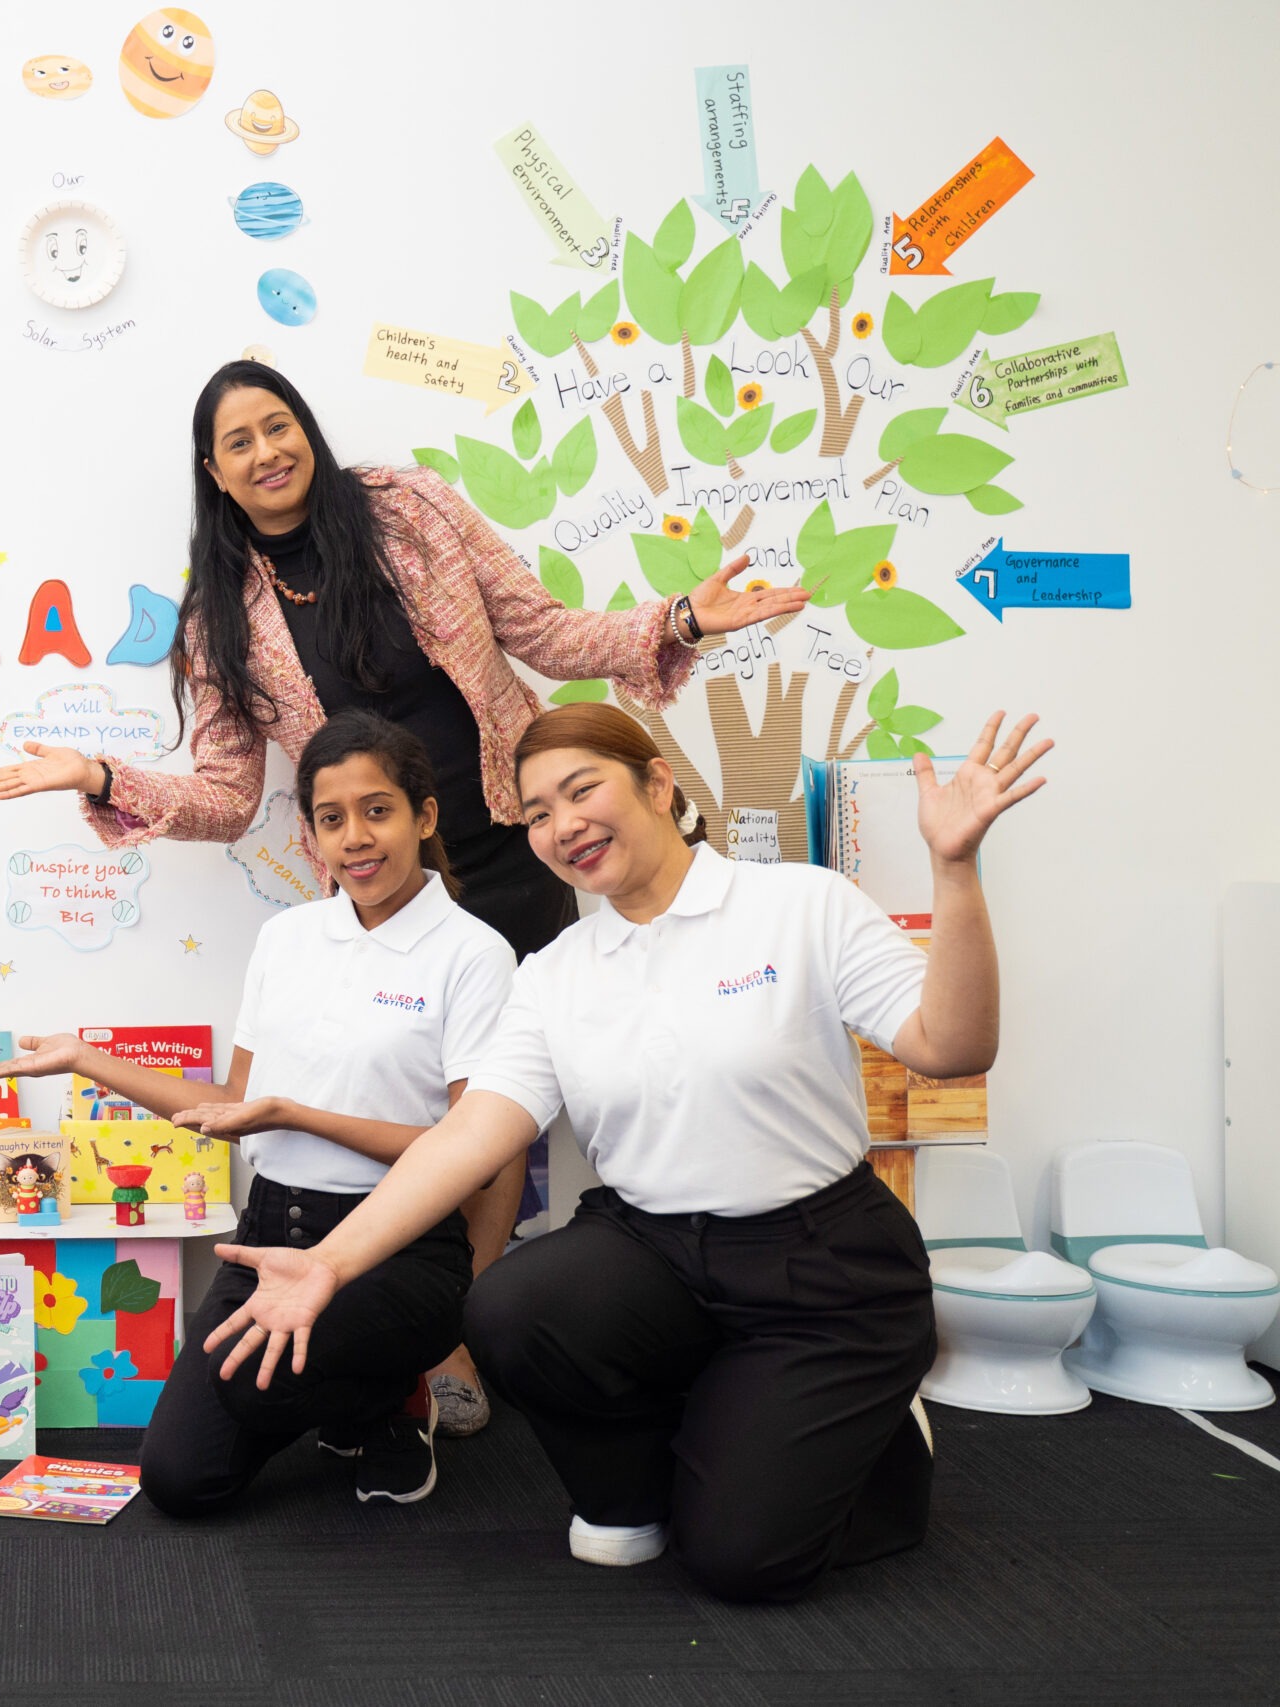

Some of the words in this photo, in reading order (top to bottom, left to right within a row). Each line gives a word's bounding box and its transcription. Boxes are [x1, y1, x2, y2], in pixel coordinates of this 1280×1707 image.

[726, 72, 749, 149] Staffing
[514, 129, 573, 200] Physical
[704, 98, 729, 205] arrangements
[52, 172, 84, 188] Our
[512, 164, 581, 253] environment
[752, 193, 777, 220] Quality
[908, 161, 983, 231] Relationships
[720, 198, 751, 225] 4
[883, 216, 891, 234] Area
[945, 199, 996, 247] Children
[611, 217, 623, 248] Quality
[738, 224, 753, 240] Area
[927, 214, 951, 238] with
[579, 236, 610, 268] 3
[611, 253, 619, 271] Area
[880, 242, 891, 274] Quality
[892, 232, 925, 271] 5
[22, 319, 58, 348] Solar
[82, 319, 136, 351] System
[377, 329, 436, 350] Children's
[386, 346, 428, 366] health
[436, 358, 459, 371] and
[506, 334, 527, 364] Quality
[526, 365, 540, 383] Area
[995, 346, 1081, 379] Collaborative
[497, 360, 521, 394] 2
[553, 369, 632, 409] Have
[648, 362, 673, 384] a
[731, 340, 811, 380] Look
[846, 356, 905, 402] Our
[951, 370, 973, 399] Quality
[969, 349, 981, 366] Area
[1007, 366, 1068, 392] Partnerships
[1075, 357, 1099, 371] with
[1046, 389, 1063, 401] and
[1068, 374, 1118, 394] communities
[970, 375, 994, 409] 6
[554, 491, 655, 553] Quality
[670, 457, 851, 521] Improvement
[874, 478, 930, 528] Plan
[744, 538, 794, 569] and
[955, 553, 983, 578] Quality
[981, 536, 996, 551] Area
[1005, 555, 1080, 569] Governance
[1016, 572, 1038, 584] and
[1032, 589, 1102, 607] Leadership
[690, 623, 777, 680] rength
[806, 624, 862, 677] Tree
[64, 699, 102, 714] Will
[13, 726, 90, 738] EXPAND
[96, 726, 153, 743] YOUR
[728, 809, 778, 824] National
[727, 829, 777, 847] Quality
[30, 860, 90, 883] Inspire
[95, 862, 129, 883] you
[256, 846, 315, 901] Dreams
[40, 885, 61, 899] To
[66, 884, 117, 901] think
[61, 909, 95, 926] BIG
[718, 970, 761, 988] ALLIED
[718, 975, 777, 995] INSTITUTE
[372, 996, 424, 1012] INSTITUTE
[376, 991, 414, 1004] ALLIED
[116, 1042, 148, 1054] First
[152, 1041, 202, 1059] Writing
[33, 1140, 64, 1149] Kitten!
[0, 1275, 18, 1294] TO
[46, 1464, 125, 1476] Phonics
